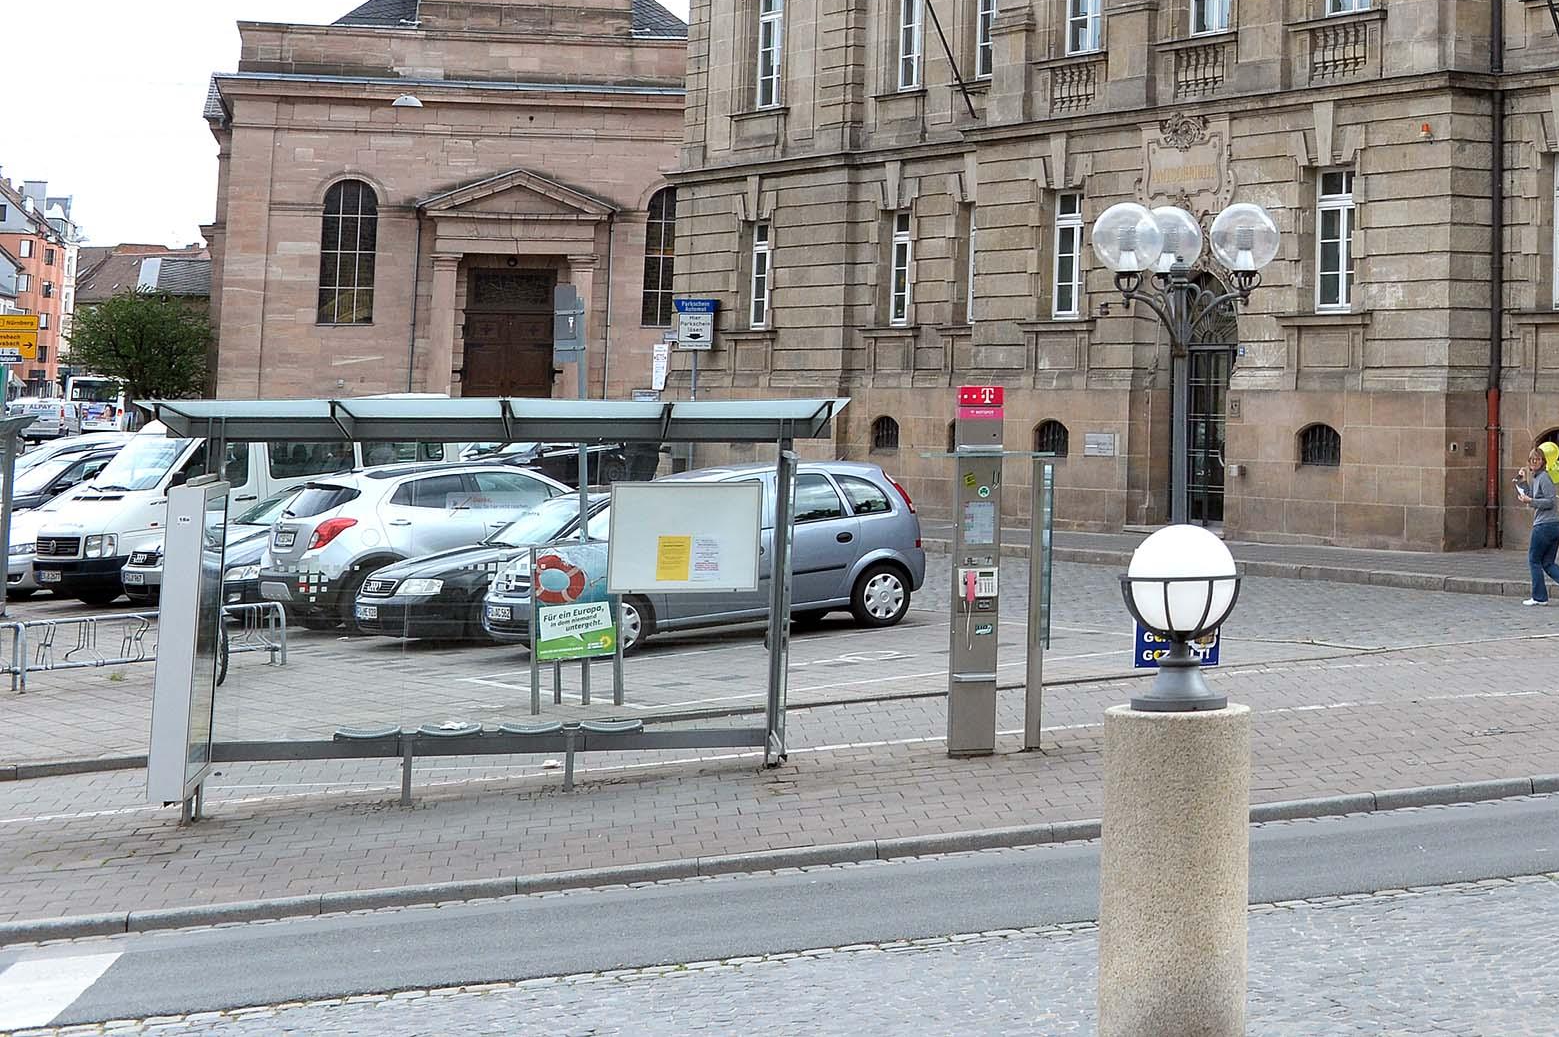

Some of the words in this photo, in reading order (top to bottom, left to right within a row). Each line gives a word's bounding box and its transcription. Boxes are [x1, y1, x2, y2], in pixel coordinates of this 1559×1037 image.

[543, 613, 558, 622] Für
[559, 610, 571, 619] ein
[573, 605, 604, 617] Europa,
[557, 618, 570, 626] dem
[571, 613, 598, 623] niemand
[565, 619, 603, 632] untergeht.
